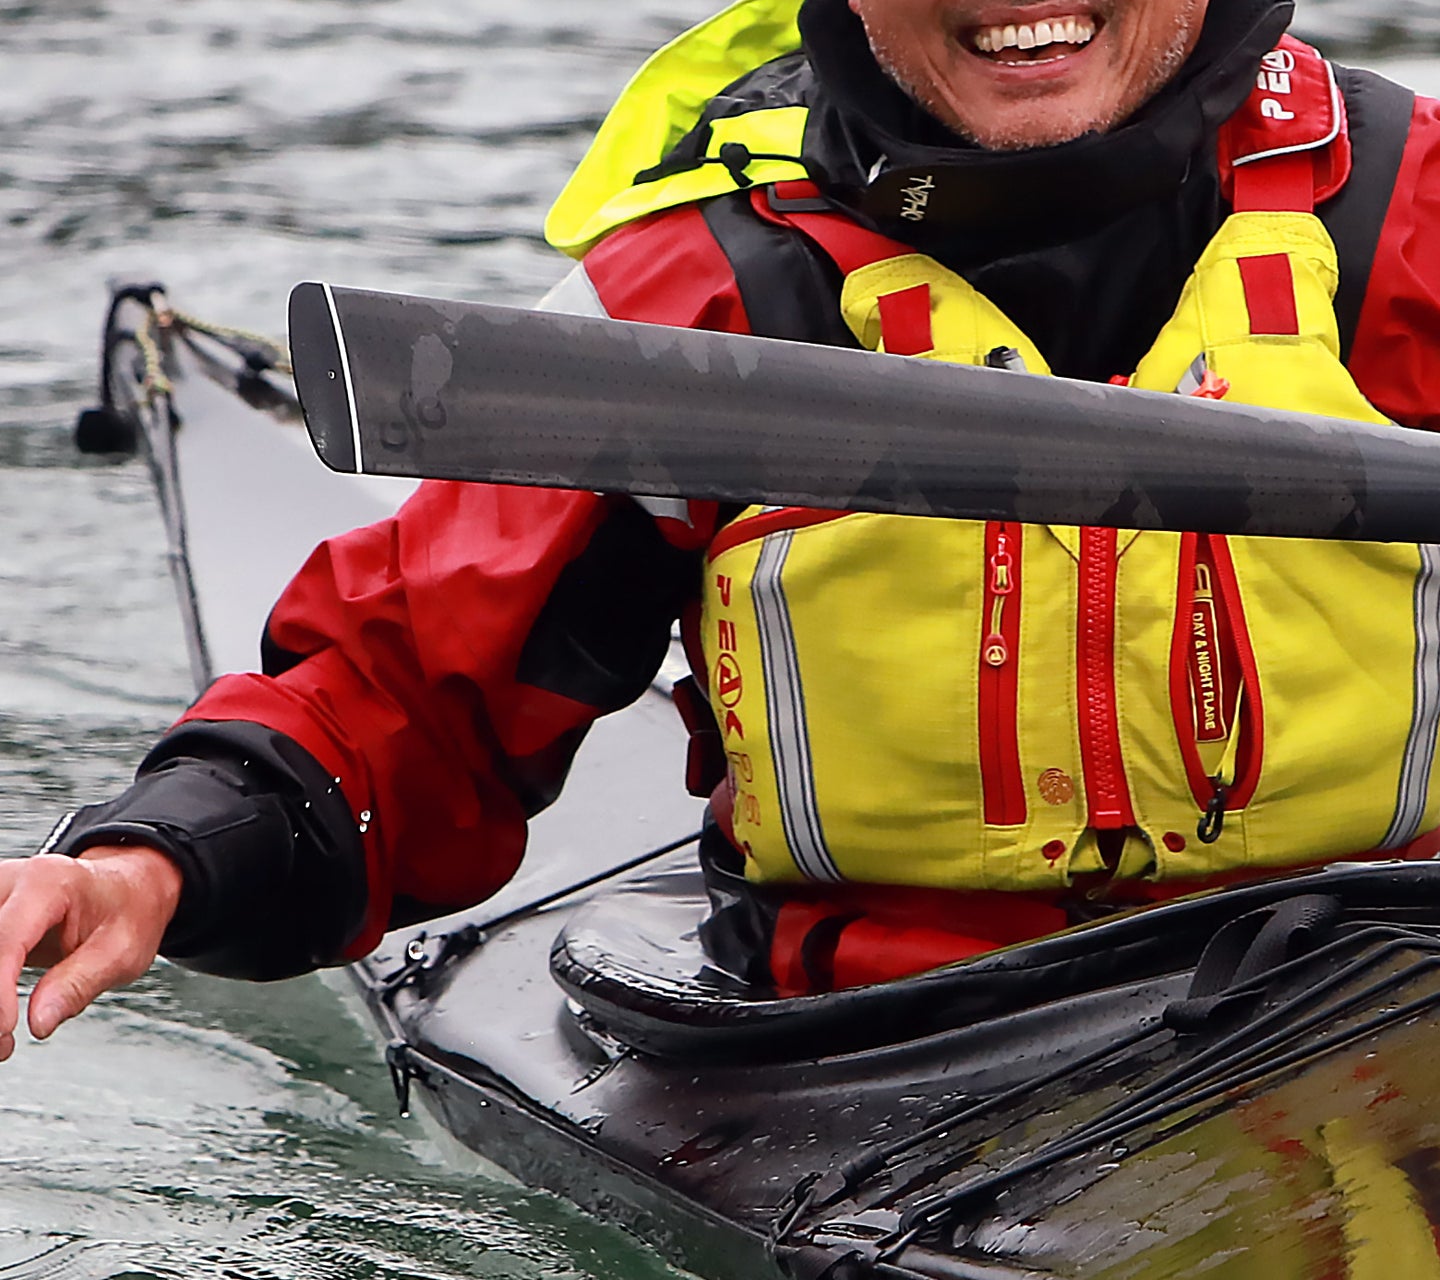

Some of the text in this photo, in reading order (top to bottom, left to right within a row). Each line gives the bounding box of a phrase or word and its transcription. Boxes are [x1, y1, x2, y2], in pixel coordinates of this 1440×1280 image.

[1192, 612, 1207, 637] DAY
[1194, 639, 1208, 650] &
[1196, 651, 1214, 689] NIGHT
